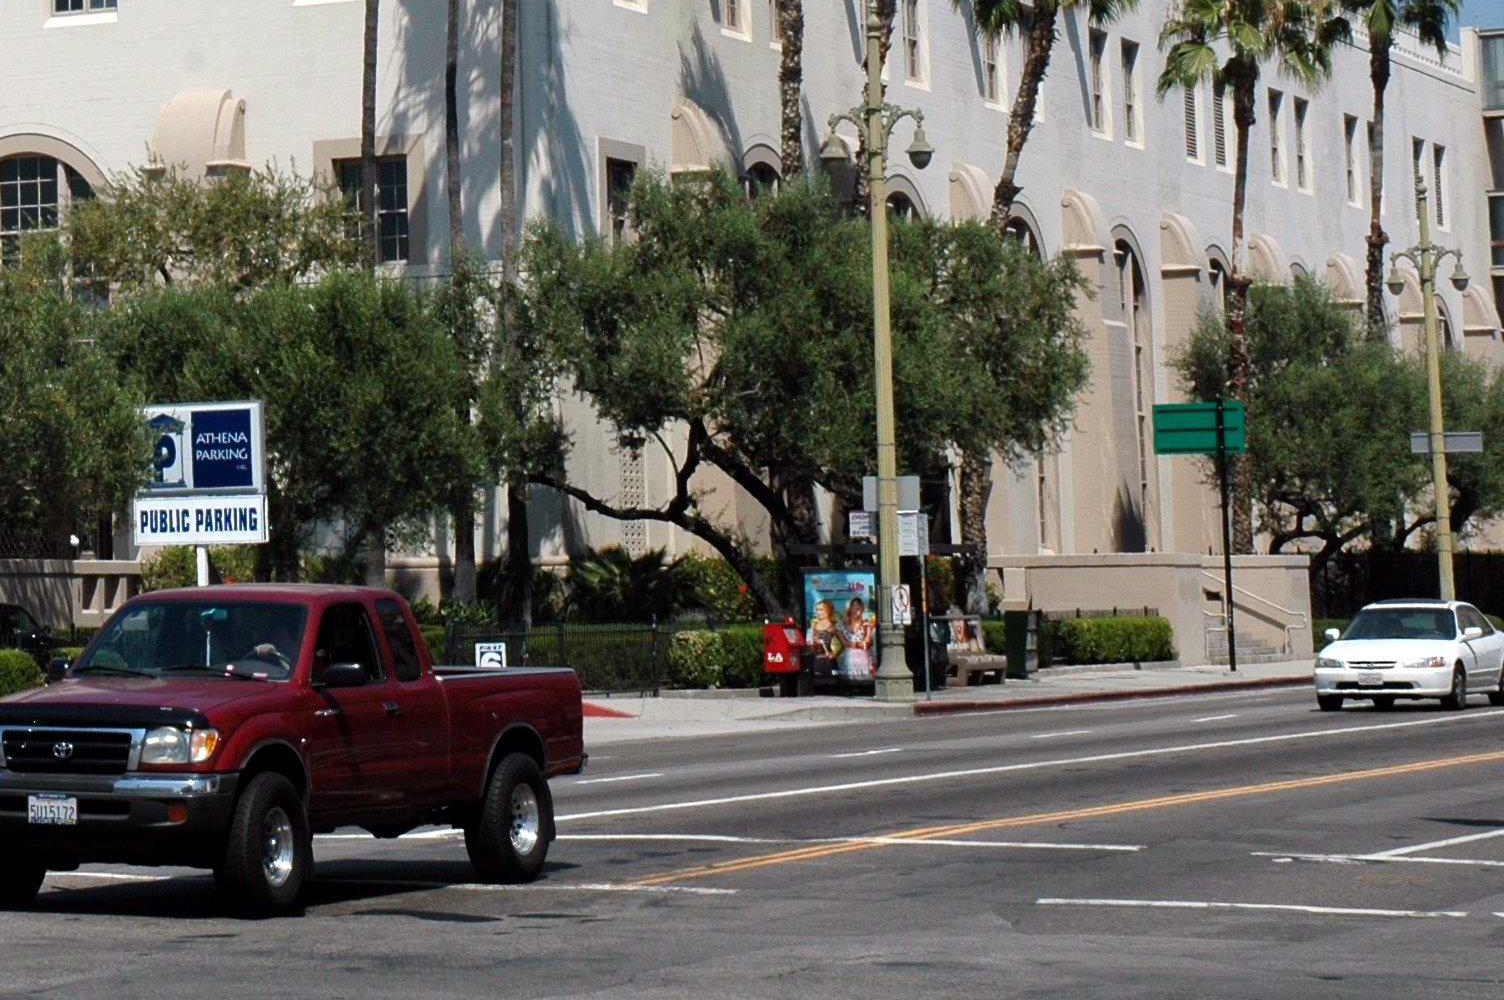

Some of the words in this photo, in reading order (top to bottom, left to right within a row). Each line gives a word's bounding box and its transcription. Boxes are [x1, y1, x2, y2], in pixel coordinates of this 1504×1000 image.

[196, 432, 248, 445] ATHENA
[196, 448, 248, 461] PARKING
[140, 509, 190, 534] PUBLIC
[195, 507, 258, 532] PARKING
